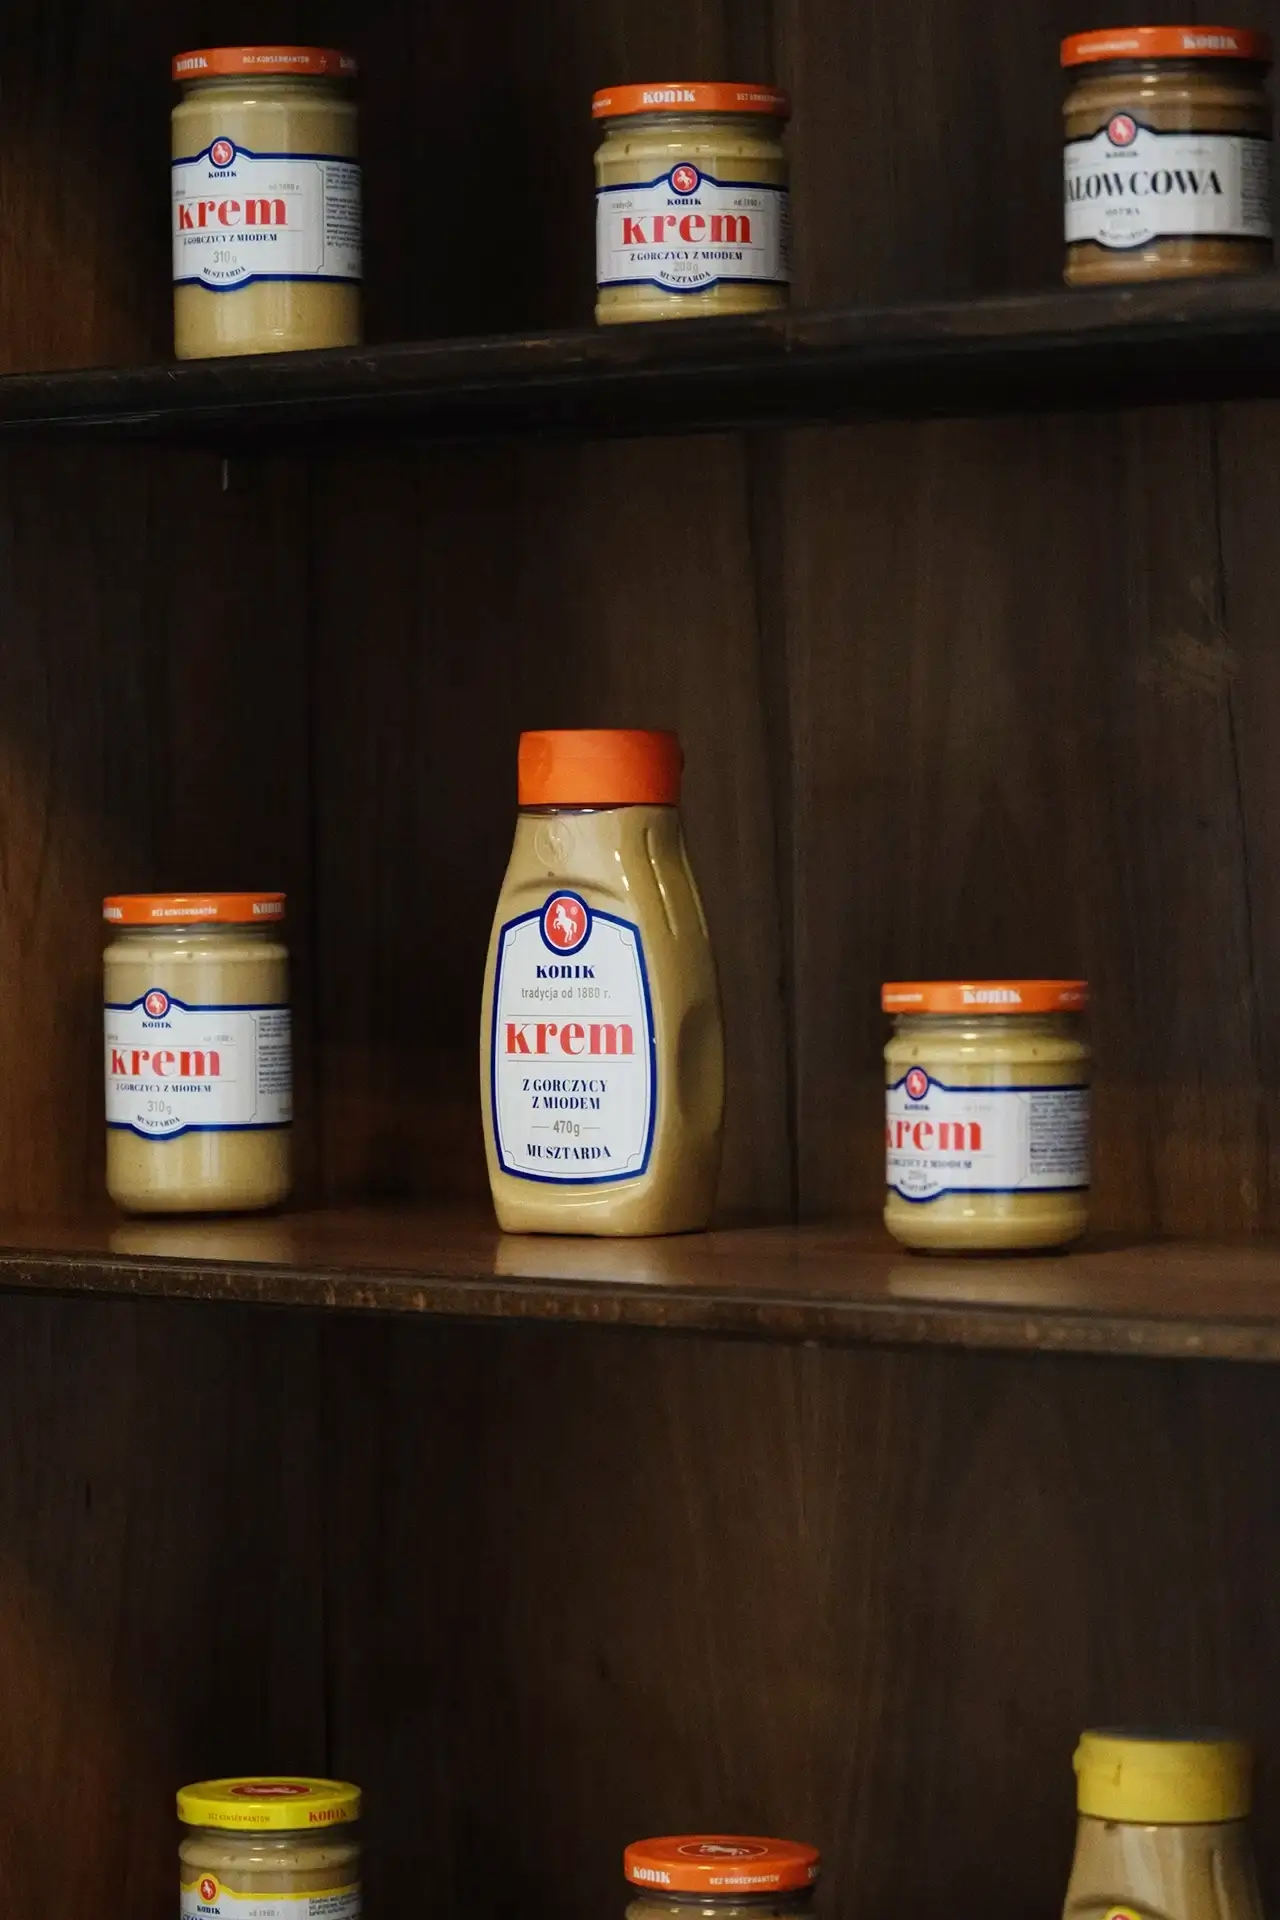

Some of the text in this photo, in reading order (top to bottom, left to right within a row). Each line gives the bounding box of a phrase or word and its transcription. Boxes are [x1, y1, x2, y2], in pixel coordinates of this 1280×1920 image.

[177, 198, 289, 231] krem
[621, 214, 753, 245] krem
[229, 234, 235, 243] Z
[237, 233, 278, 242] MIODEM
[630, 251, 743, 262] Z GORCZYCY Z MIODEM
[660, 270, 711, 284] MUSZTARDA
[521, 987, 559, 1001] tradycja
[561, 987, 573, 999] od
[577, 987, 600, 999] 1880
[504, 1023, 636, 1056] krem
[110, 1048, 222, 1078] krem
[163, 1084, 169, 1093] Z
[171, 1084, 212, 1093] MIODEM
[522, 1078, 608, 1092] Z GORCZYCY
[532, 1096, 600, 1110] Z MIODEM
[553, 1120, 580, 1137] 470g
[526, 1143, 611, 1160] MUSZTARDA
